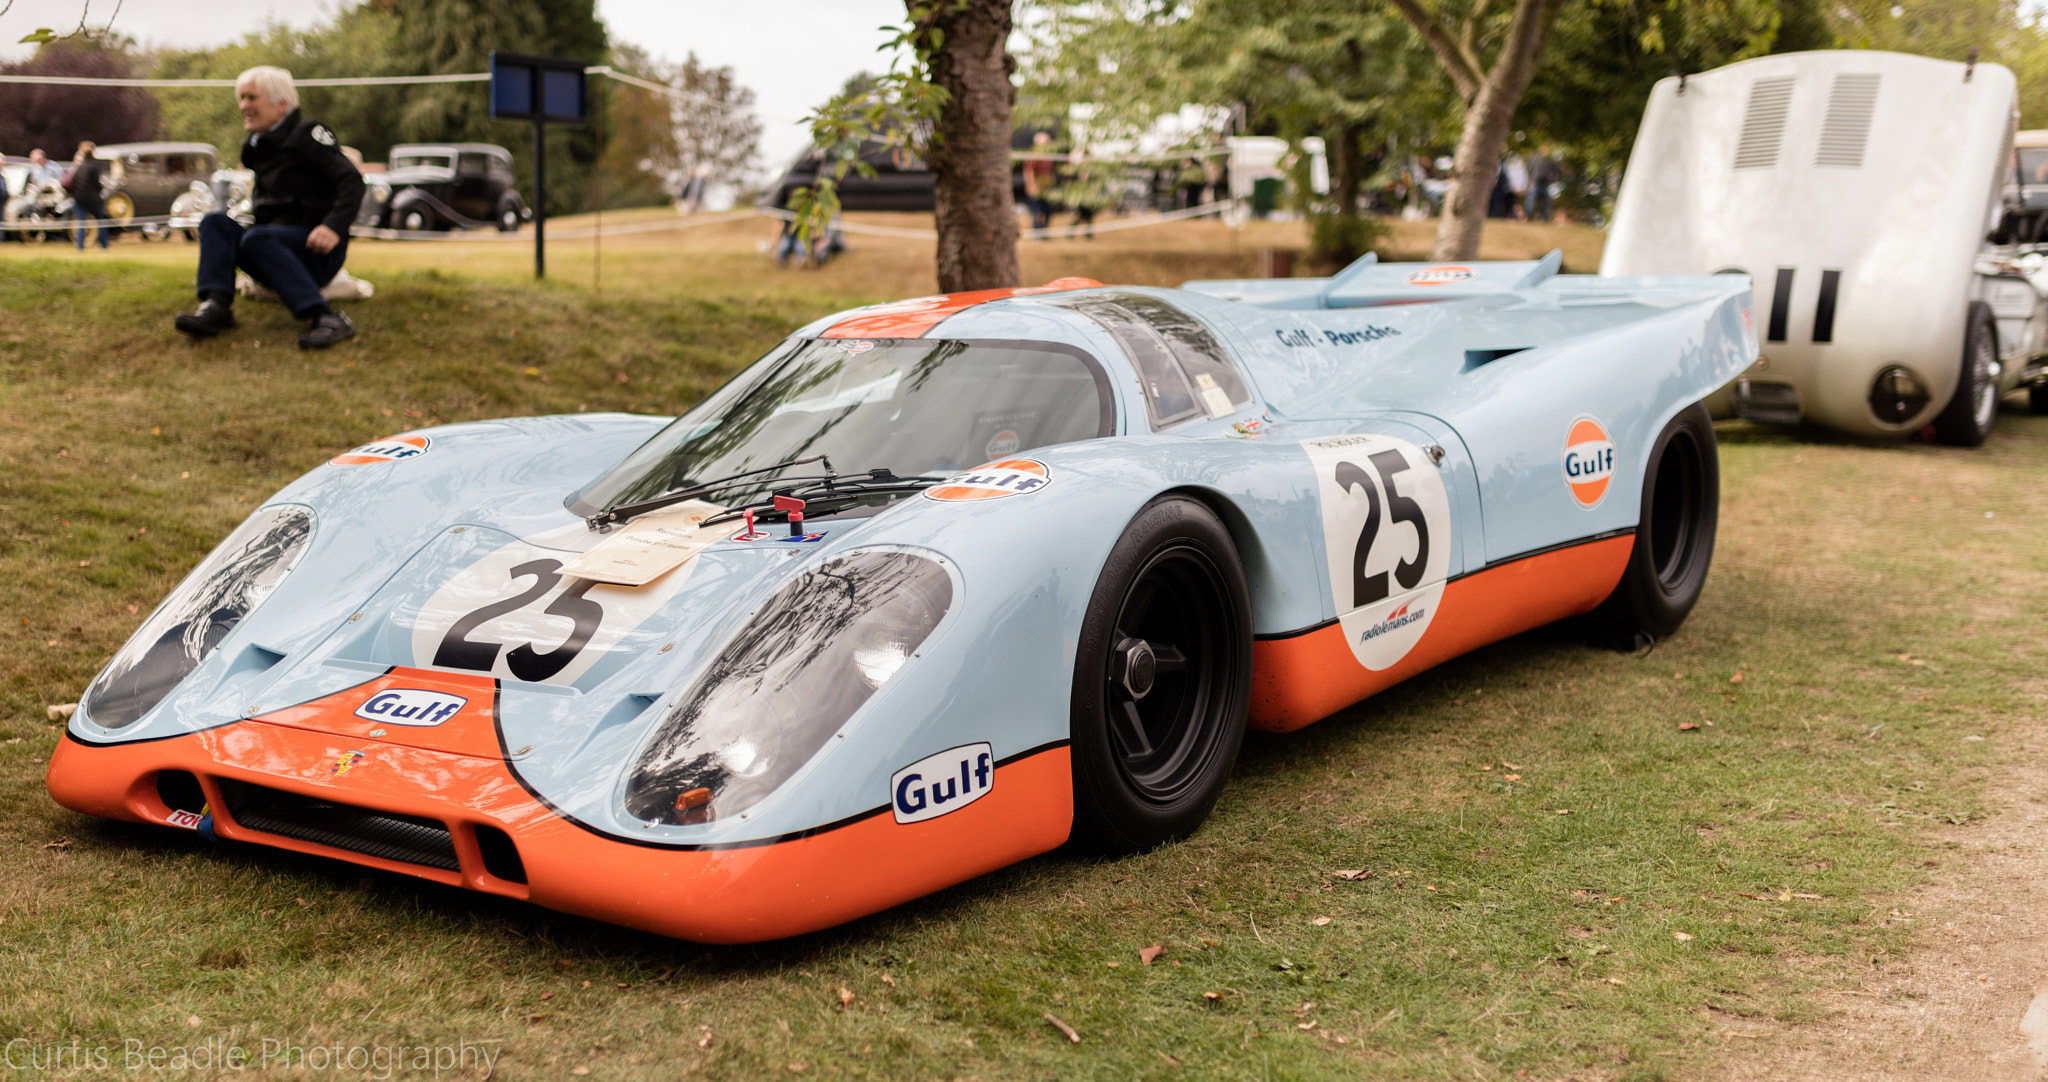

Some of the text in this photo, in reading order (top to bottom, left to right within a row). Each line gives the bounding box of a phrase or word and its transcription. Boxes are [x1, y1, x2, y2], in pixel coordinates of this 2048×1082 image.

[1322, 324, 1402, 347] Porsche
[1565, 448, 1613, 477] Gulf
[1130, 505, 1185, 549] RACING
[1335, 448, 1430, 609] 25
[431, 558, 605, 682] 25
[1359, 608, 1425, 646] radiolemans.com
[364, 693, 461, 722] Gulf
[896, 752, 990, 815] Gulf
